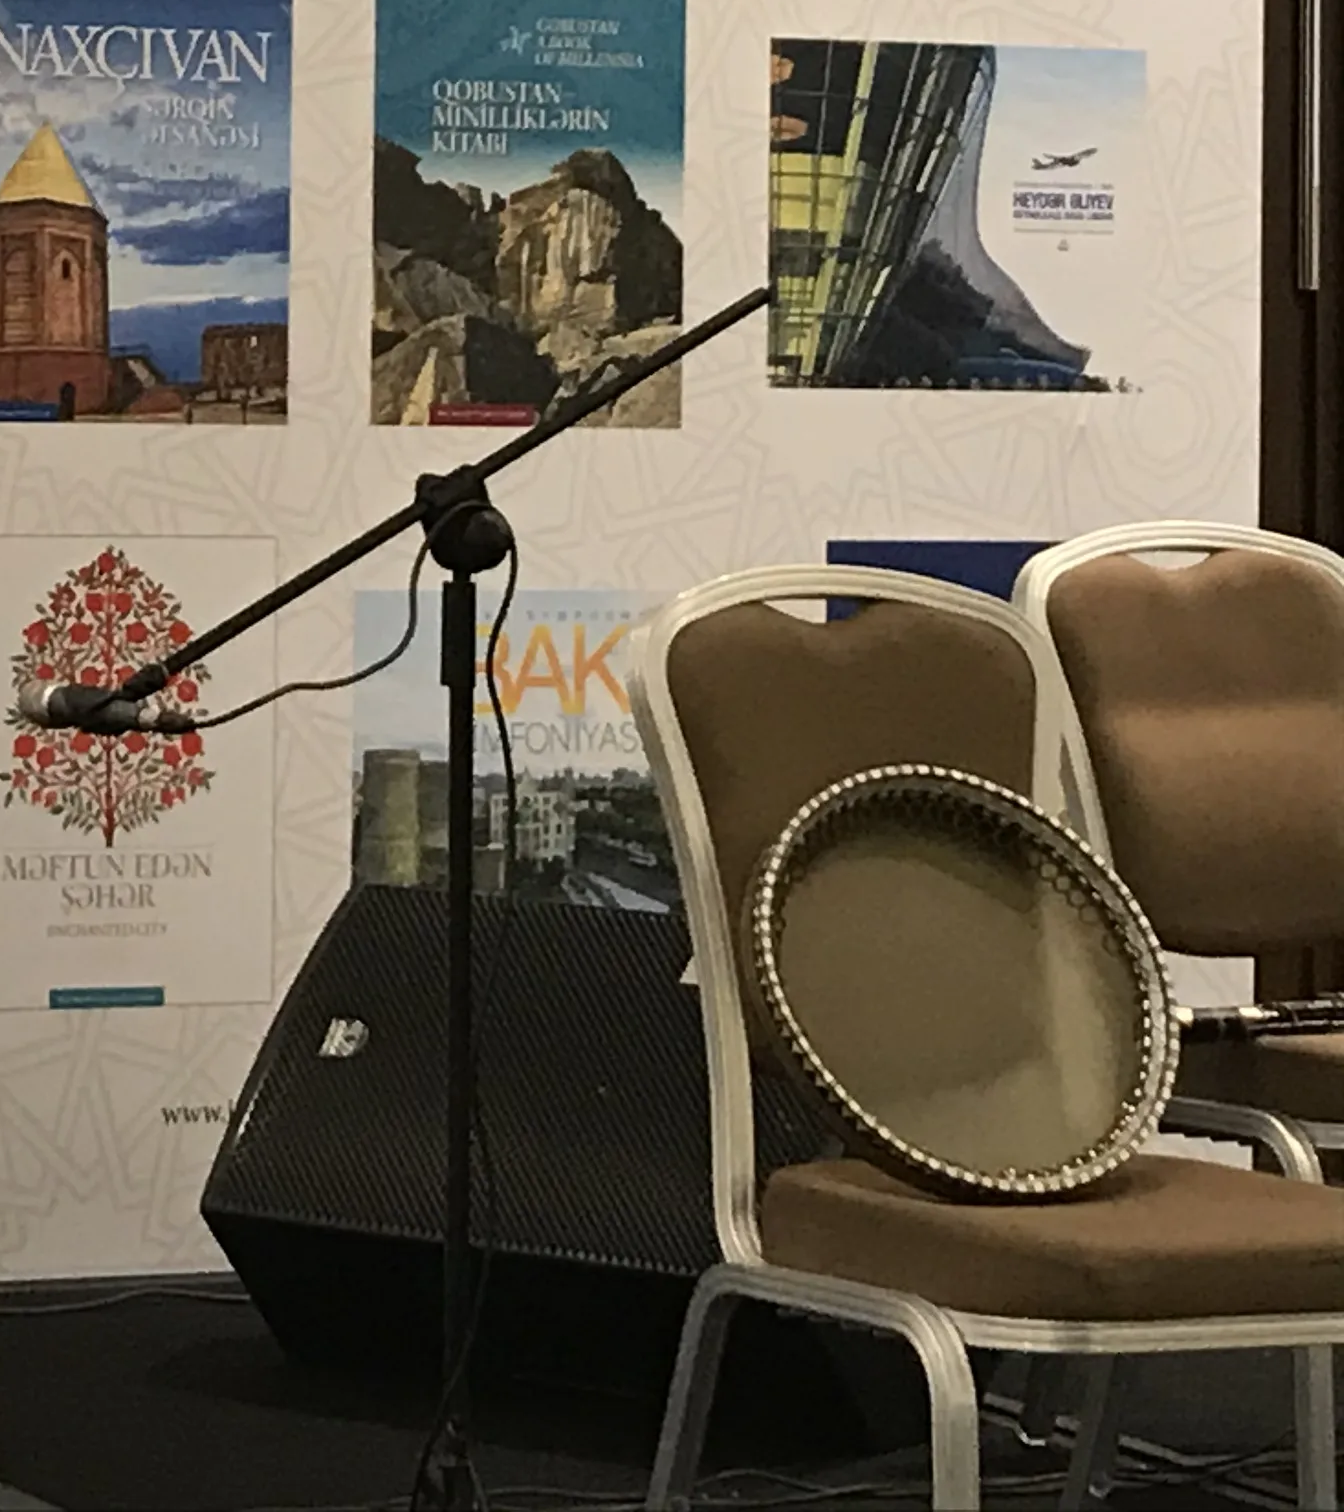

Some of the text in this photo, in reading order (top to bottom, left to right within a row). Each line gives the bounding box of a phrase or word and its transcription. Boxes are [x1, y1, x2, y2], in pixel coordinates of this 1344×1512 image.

[2, 852, 212, 881] MƏFTUN EDƏN
[61, 882, 156, 916] ŞƏHƏR
